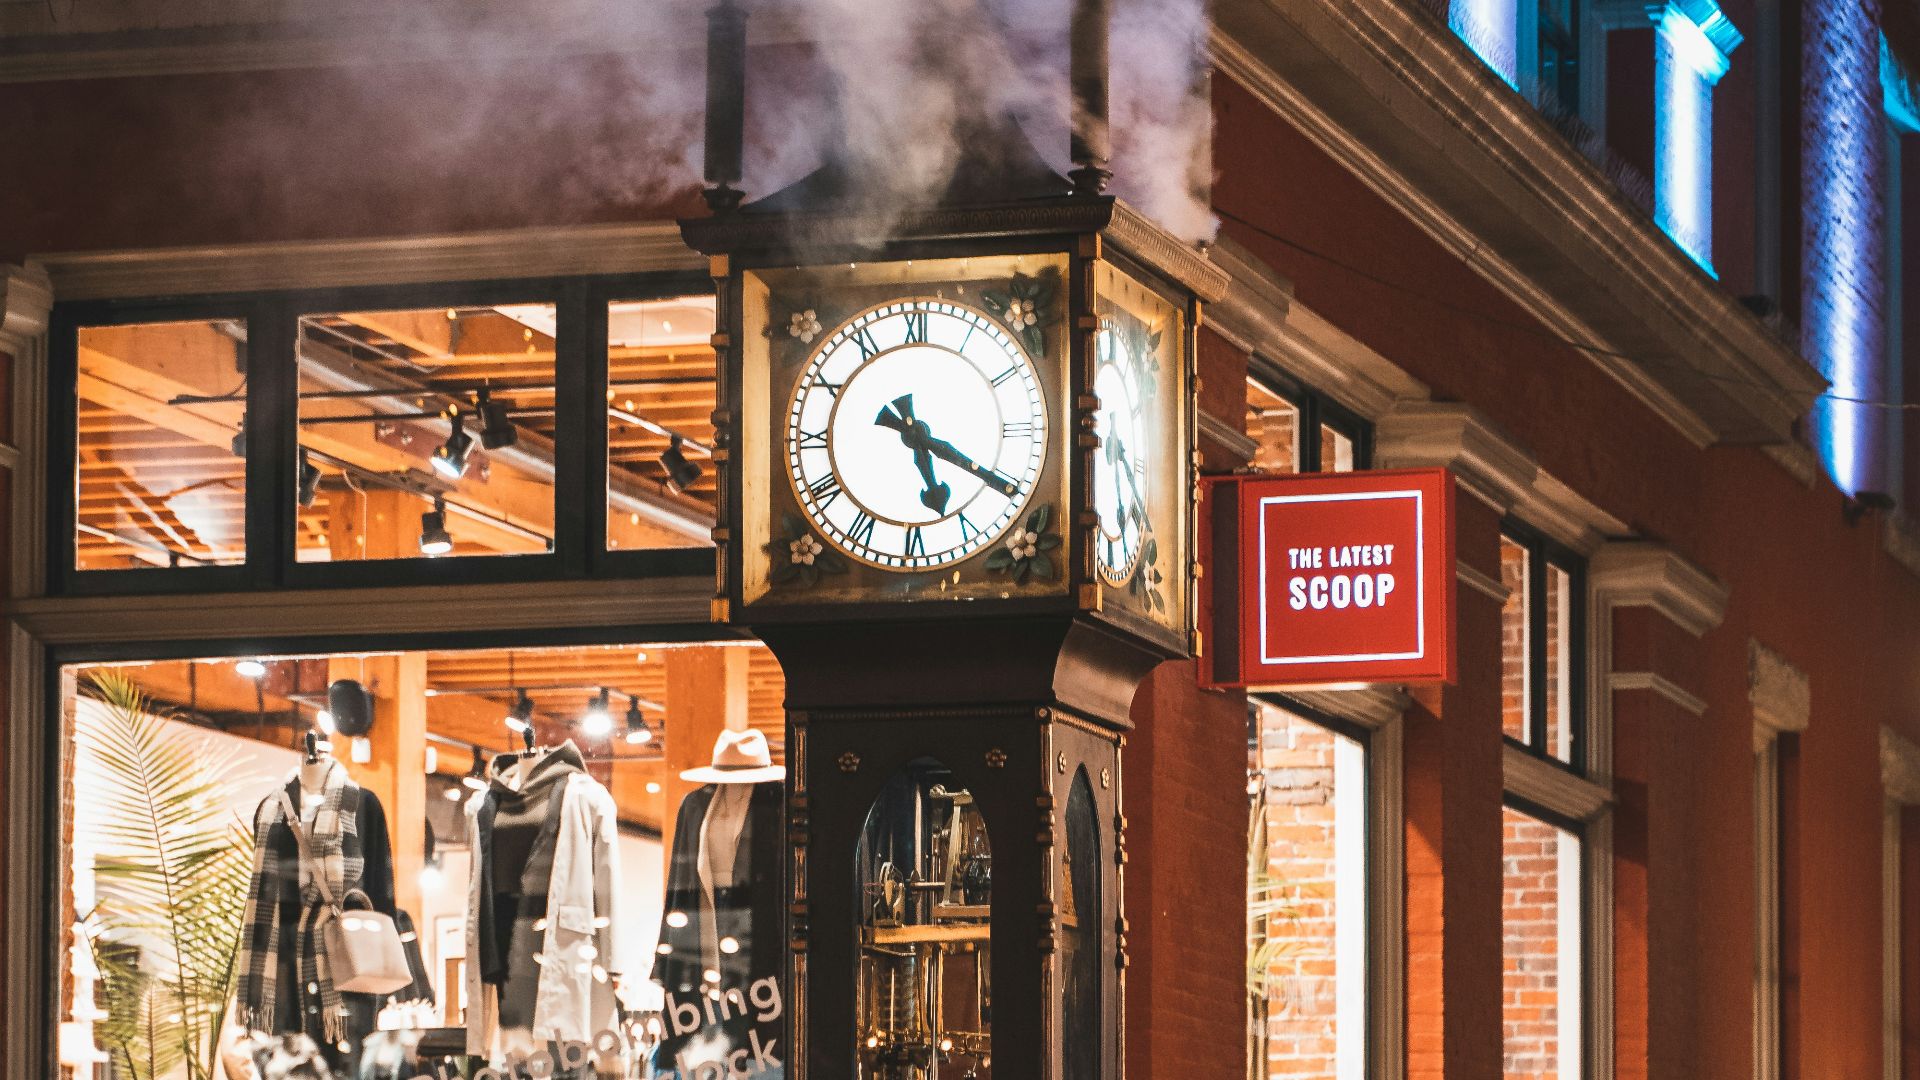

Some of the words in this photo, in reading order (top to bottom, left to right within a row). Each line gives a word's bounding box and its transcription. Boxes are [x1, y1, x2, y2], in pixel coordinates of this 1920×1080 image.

[850, 325, 879, 361] XI
[904, 313, 927, 344] XII
[959, 326, 975, 353] I
[812, 373, 843, 399] X
[989, 365, 1018, 388] II
[799, 429, 828, 449] IX
[1003, 422, 1032, 438] III
[847, 511, 877, 549] VII
[904, 526, 925, 556] VI
[959, 512, 980, 542] V
[1289, 548, 1323, 569] THE
[1329, 544, 1395, 568] LATEST
[1288, 573, 1395, 611] SCOOP
[408, 976, 783, 1080] tobombing
